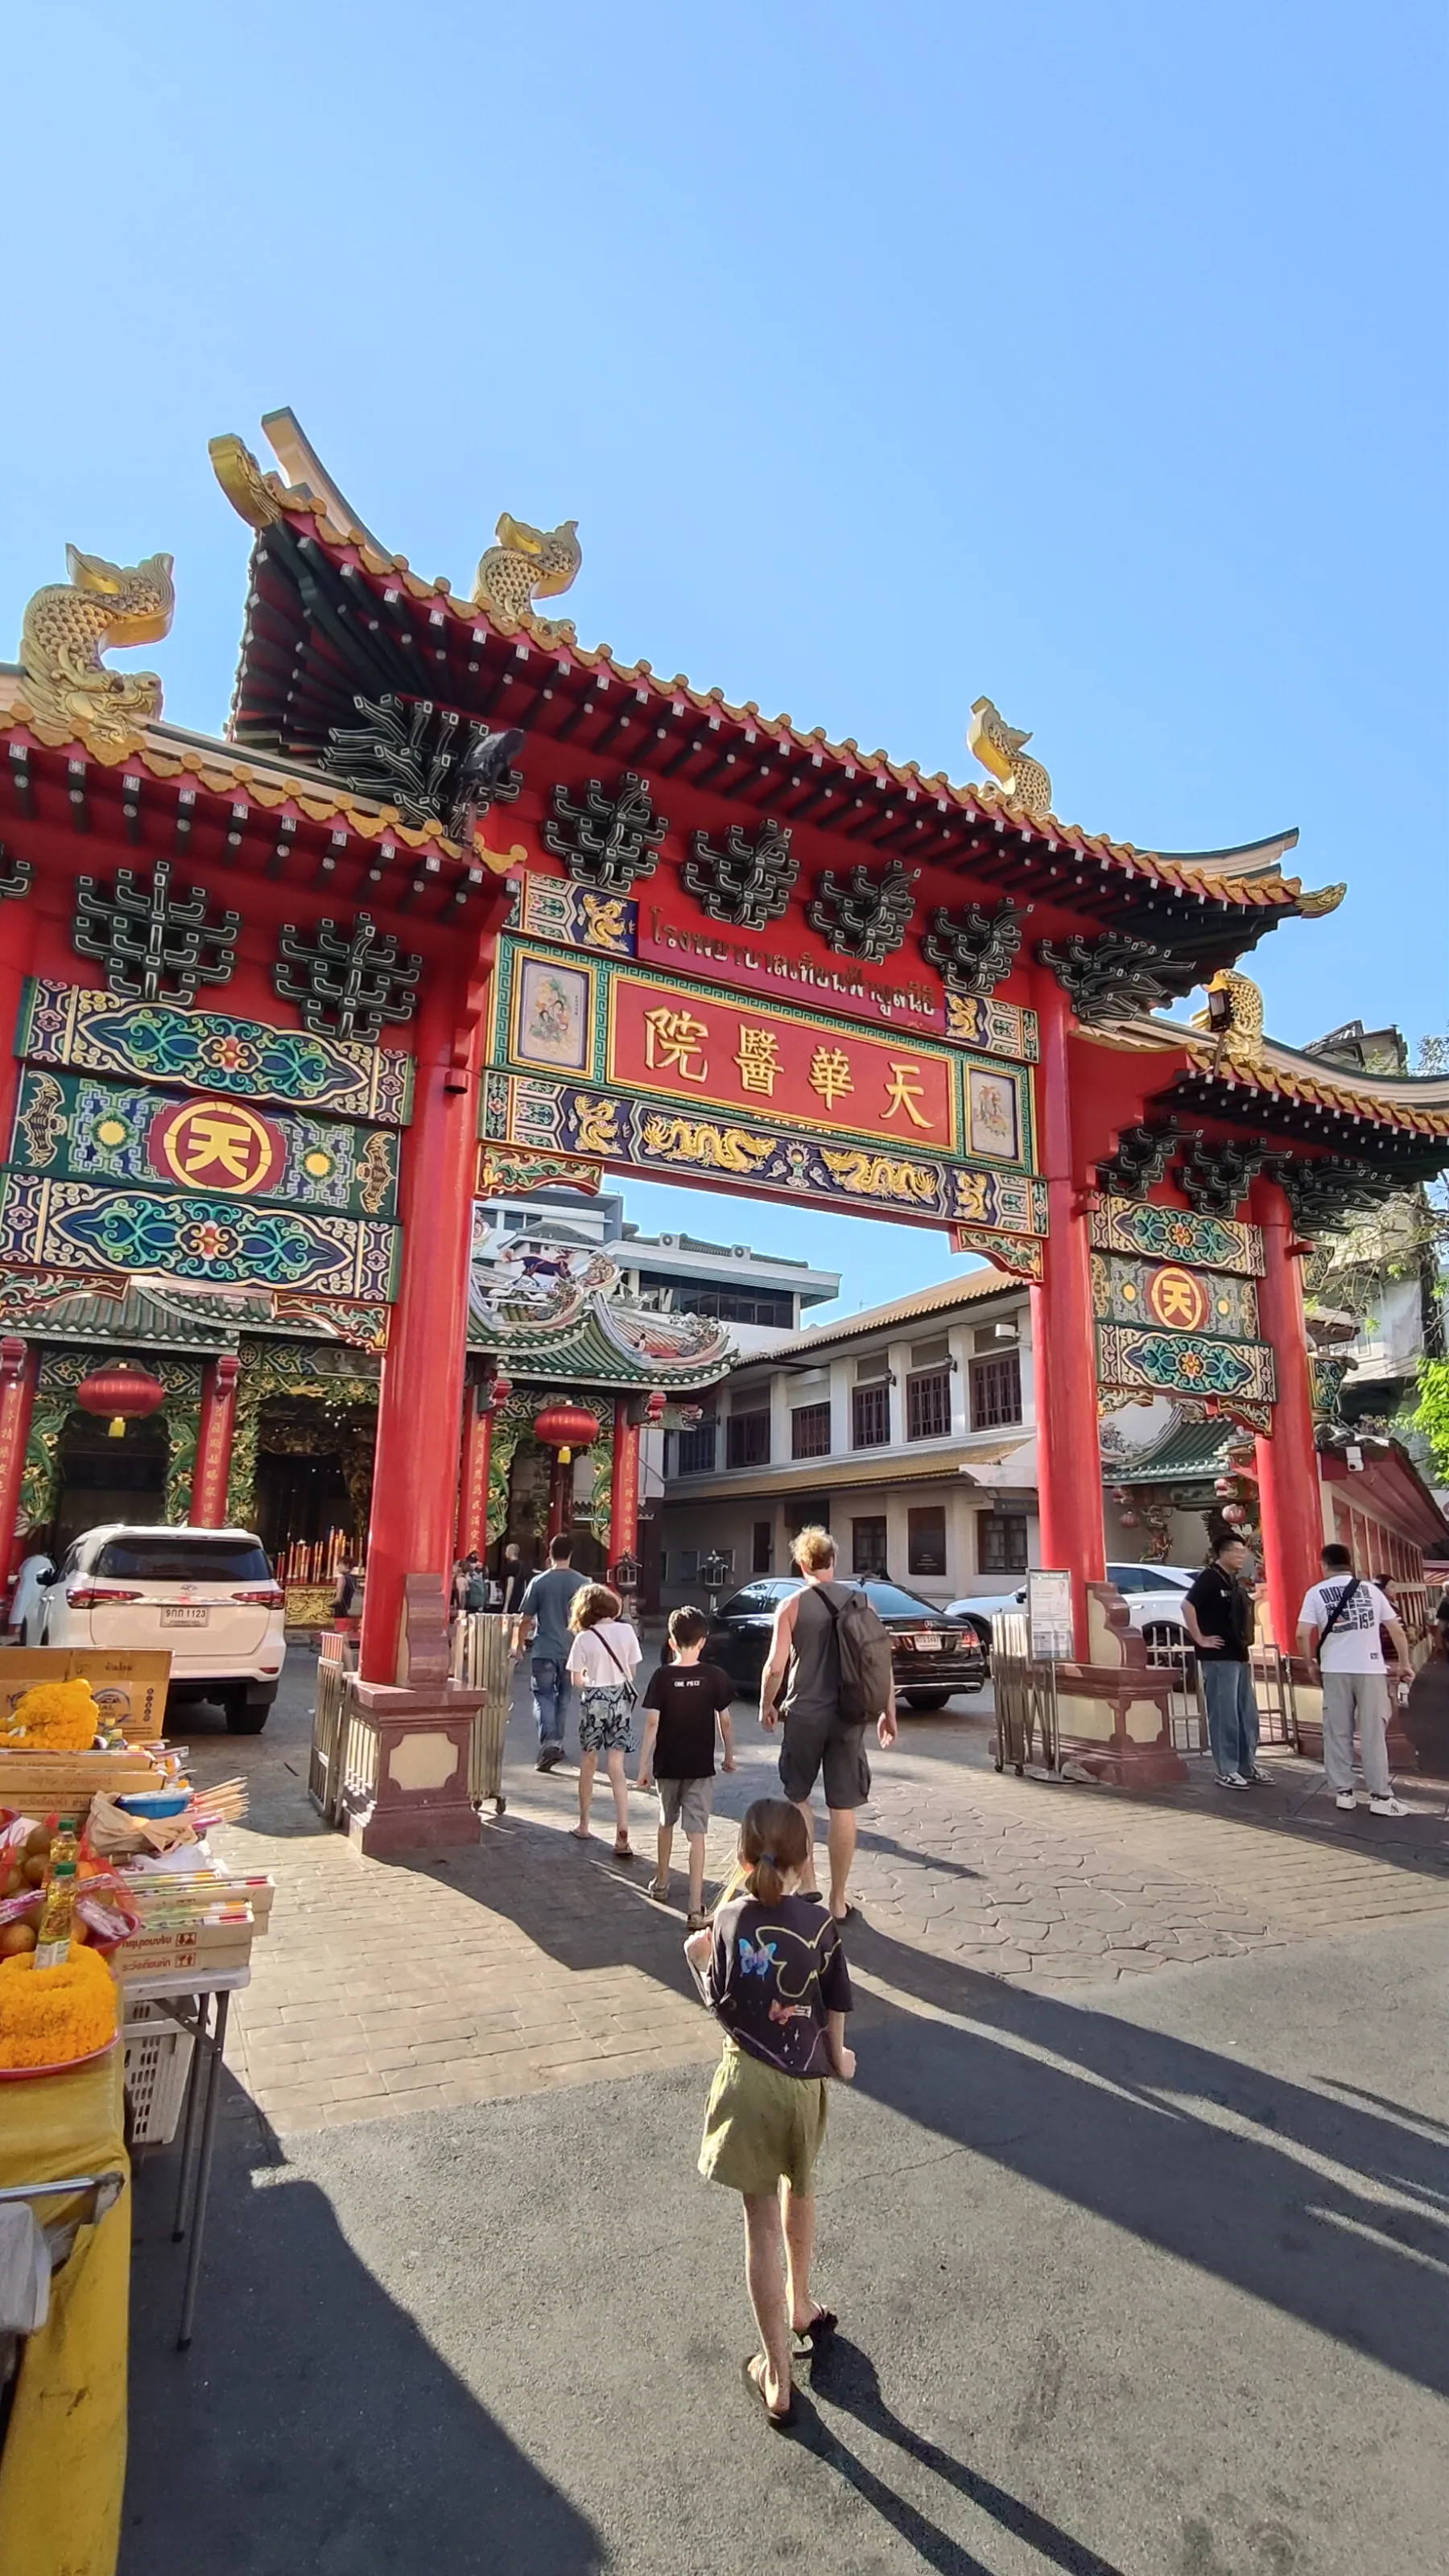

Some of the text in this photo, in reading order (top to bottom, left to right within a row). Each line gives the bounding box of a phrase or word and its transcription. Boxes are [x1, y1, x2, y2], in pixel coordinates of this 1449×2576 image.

[186, 1118, 252, 1181] 天
[1162, 1279, 1193, 1321] 天
[187, 1609, 206, 1618] 1123
